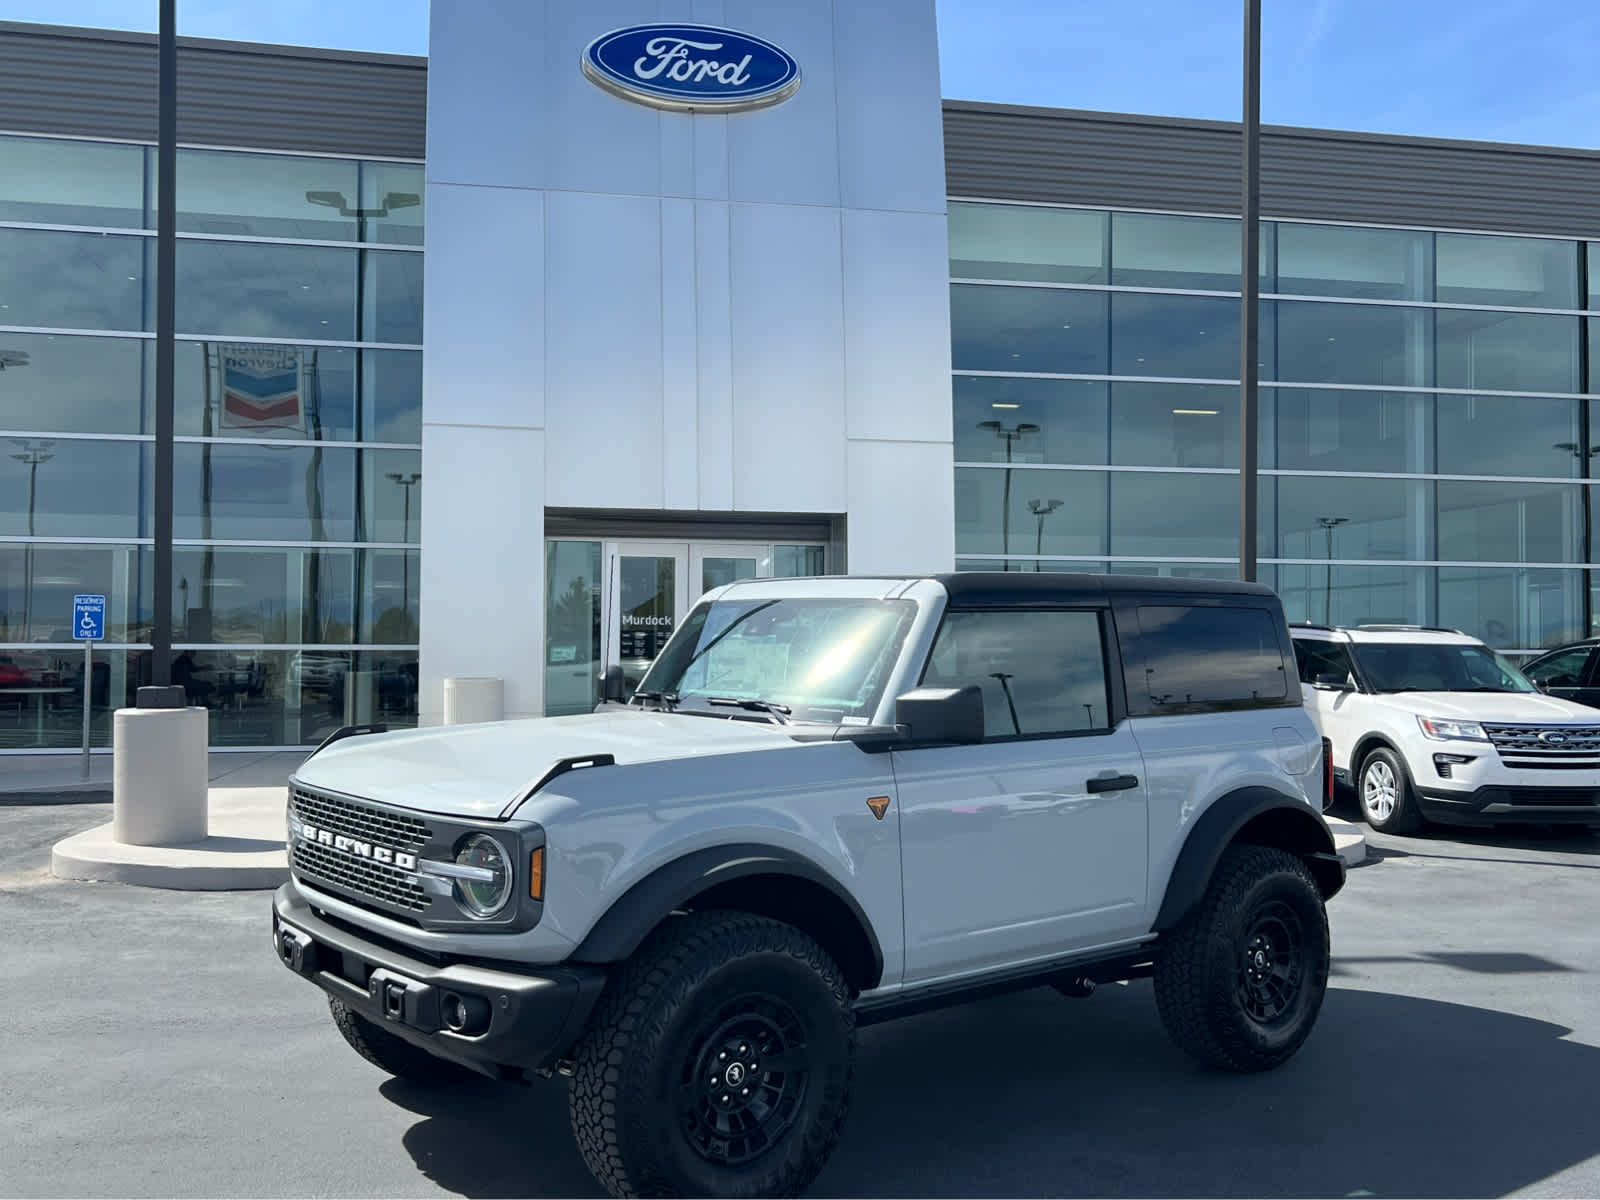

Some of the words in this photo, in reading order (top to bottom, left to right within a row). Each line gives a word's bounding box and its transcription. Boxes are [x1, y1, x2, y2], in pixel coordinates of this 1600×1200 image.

[634, 37, 753, 86] Ford
[77, 605, 102, 613] PARKING
[622, 615, 672, 626] Murdock
[80, 629, 97, 637] ONLY
[303, 824, 416, 870] BRONCO
